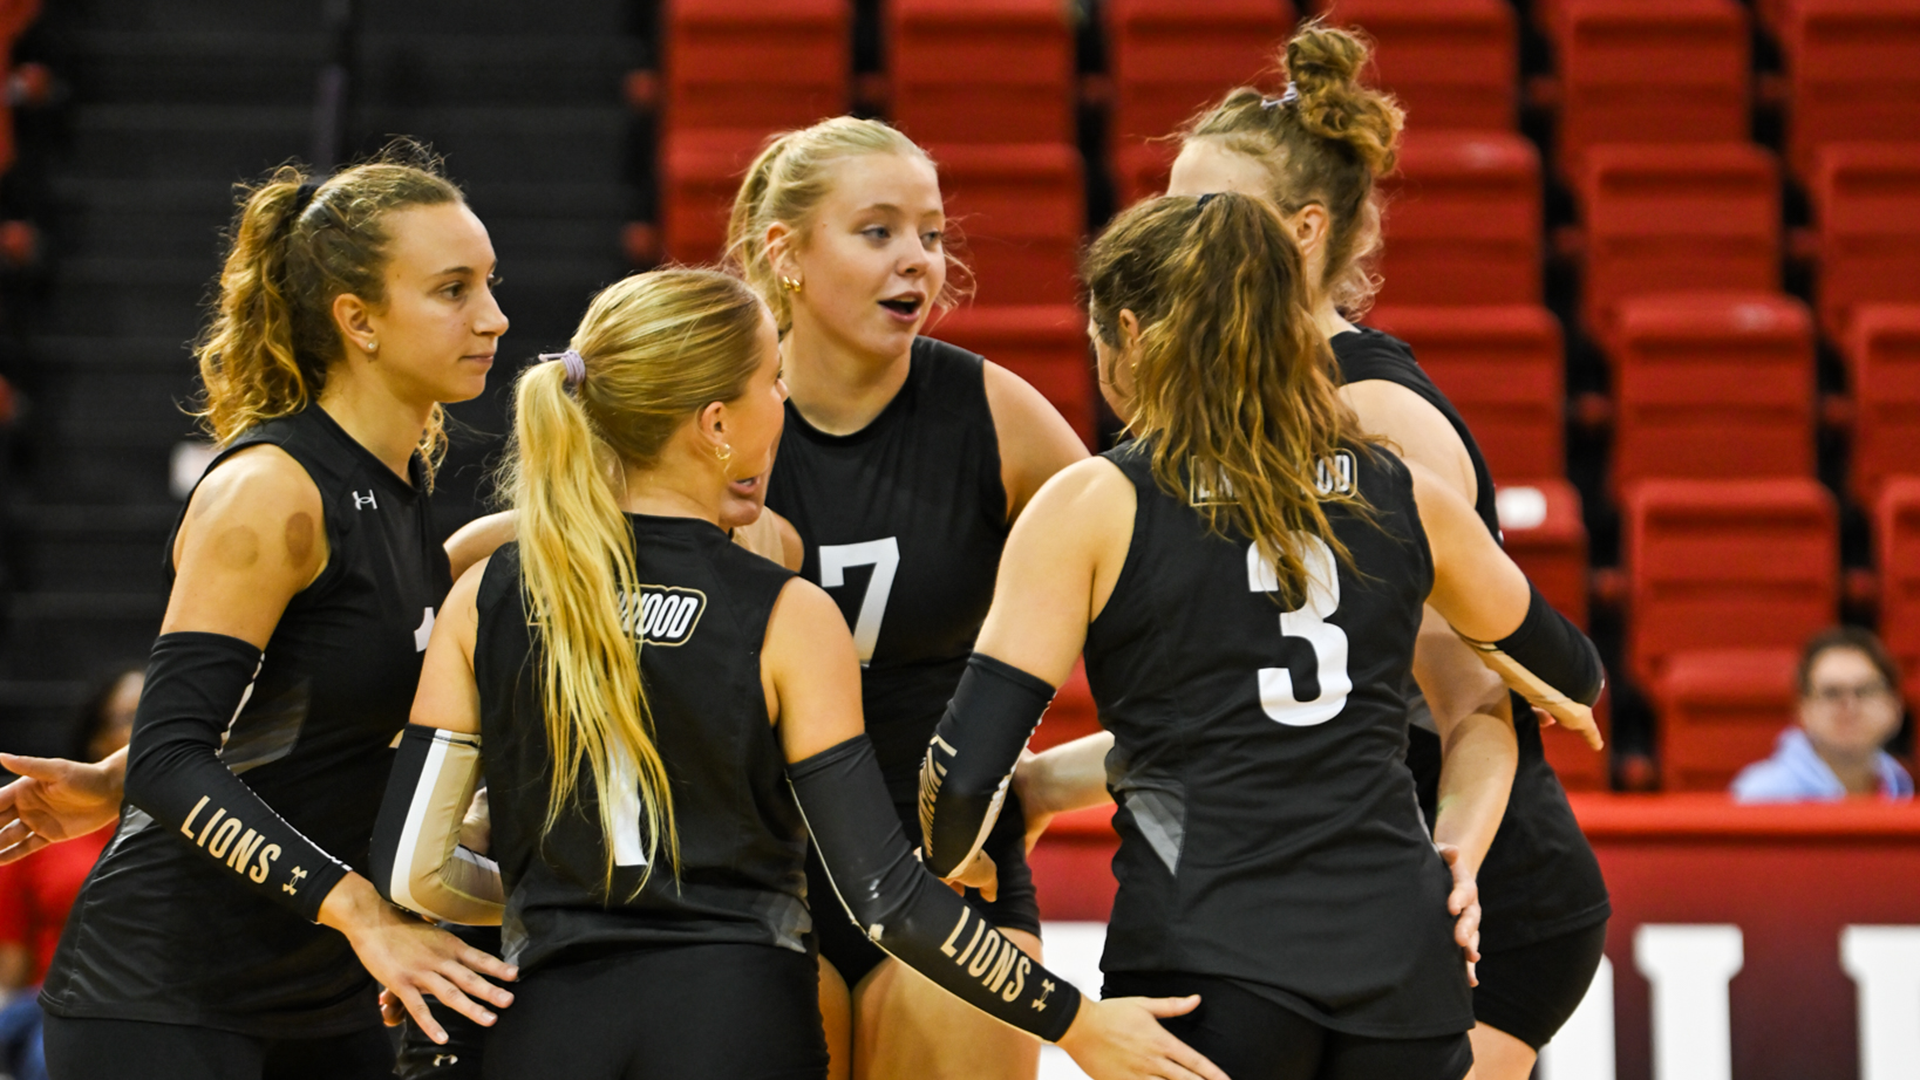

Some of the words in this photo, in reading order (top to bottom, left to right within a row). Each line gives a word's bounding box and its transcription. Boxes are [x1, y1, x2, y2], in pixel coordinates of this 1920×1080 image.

[819, 536, 900, 667] 7
[1247, 529, 1353, 727] 3
[180, 795, 282, 884] LIONS
[940, 905, 1031, 1002] LIONS
